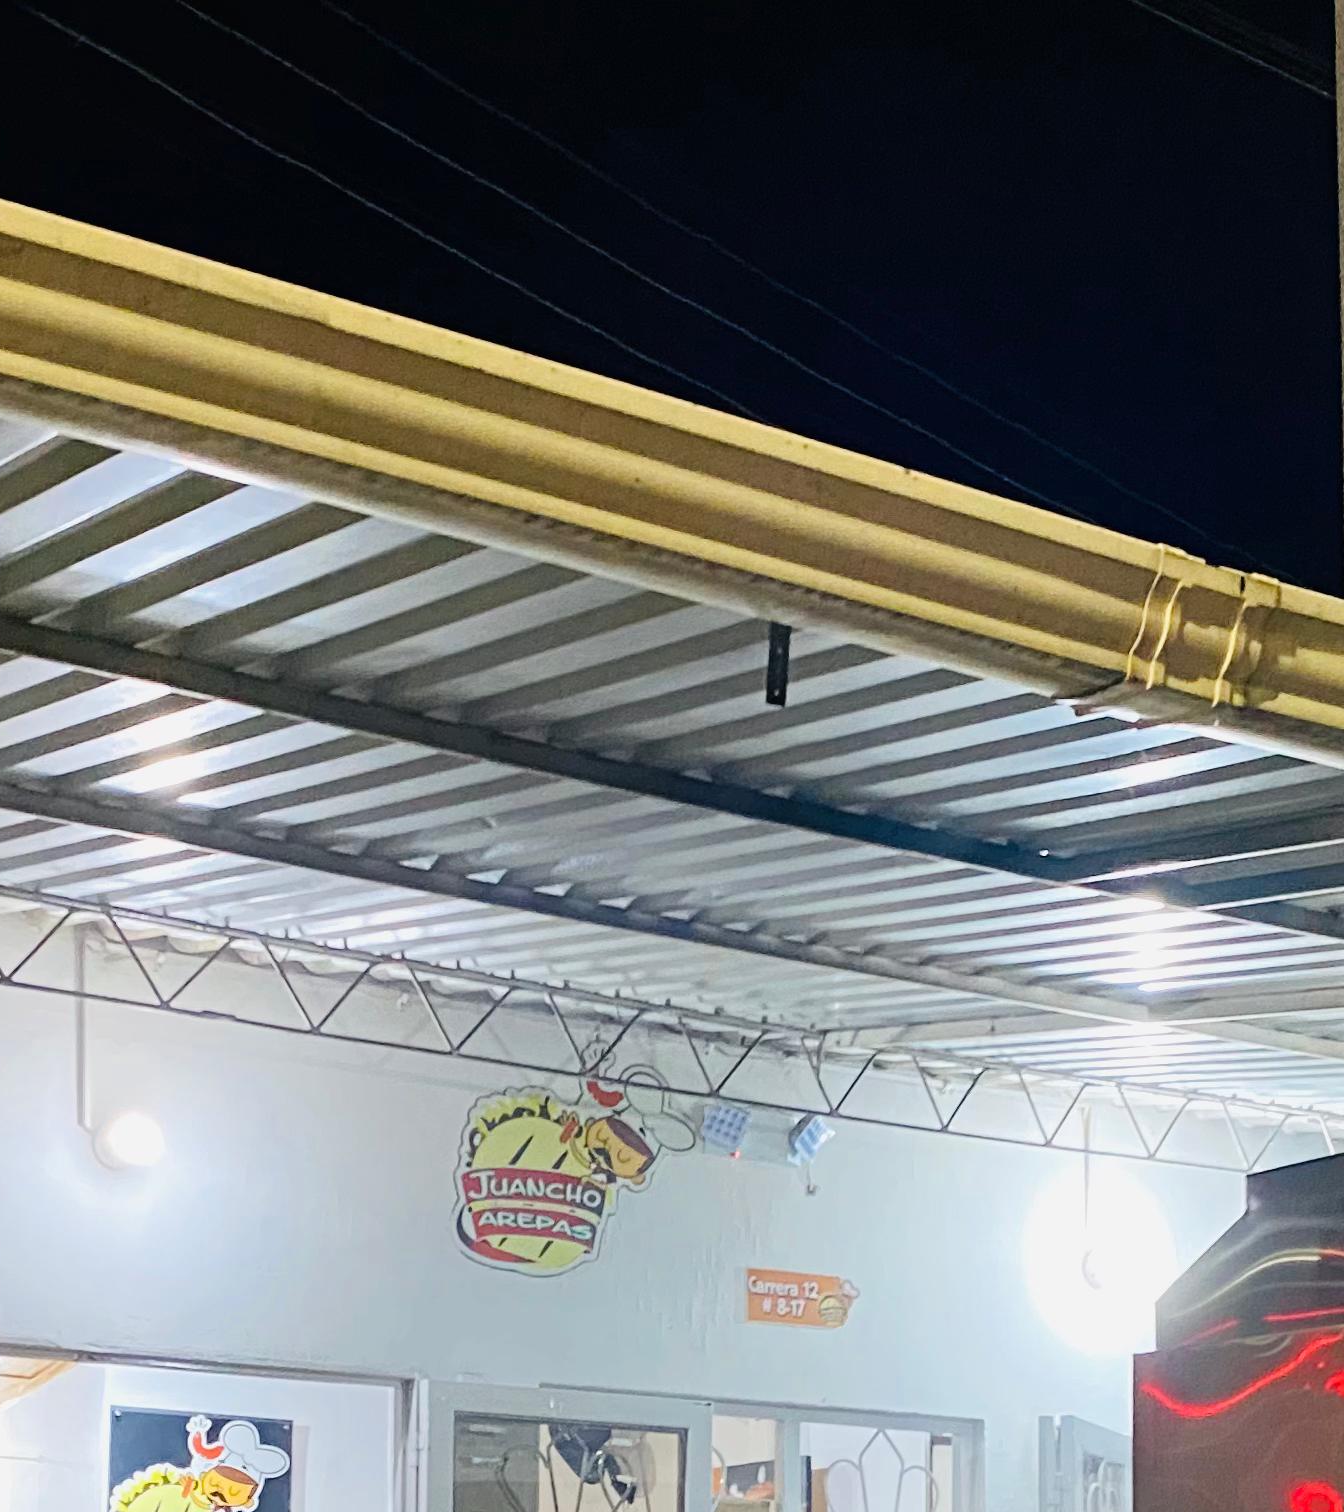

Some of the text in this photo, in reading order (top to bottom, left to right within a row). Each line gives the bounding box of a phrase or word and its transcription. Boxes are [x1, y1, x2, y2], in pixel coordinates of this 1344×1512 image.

[467, 1170, 602, 1208] JUANCHO
[478, 1211, 593, 1240] AREPAS
[748, 1275, 819, 1299] Carrera 12
[777, 1298, 806, 1317] 8-17
